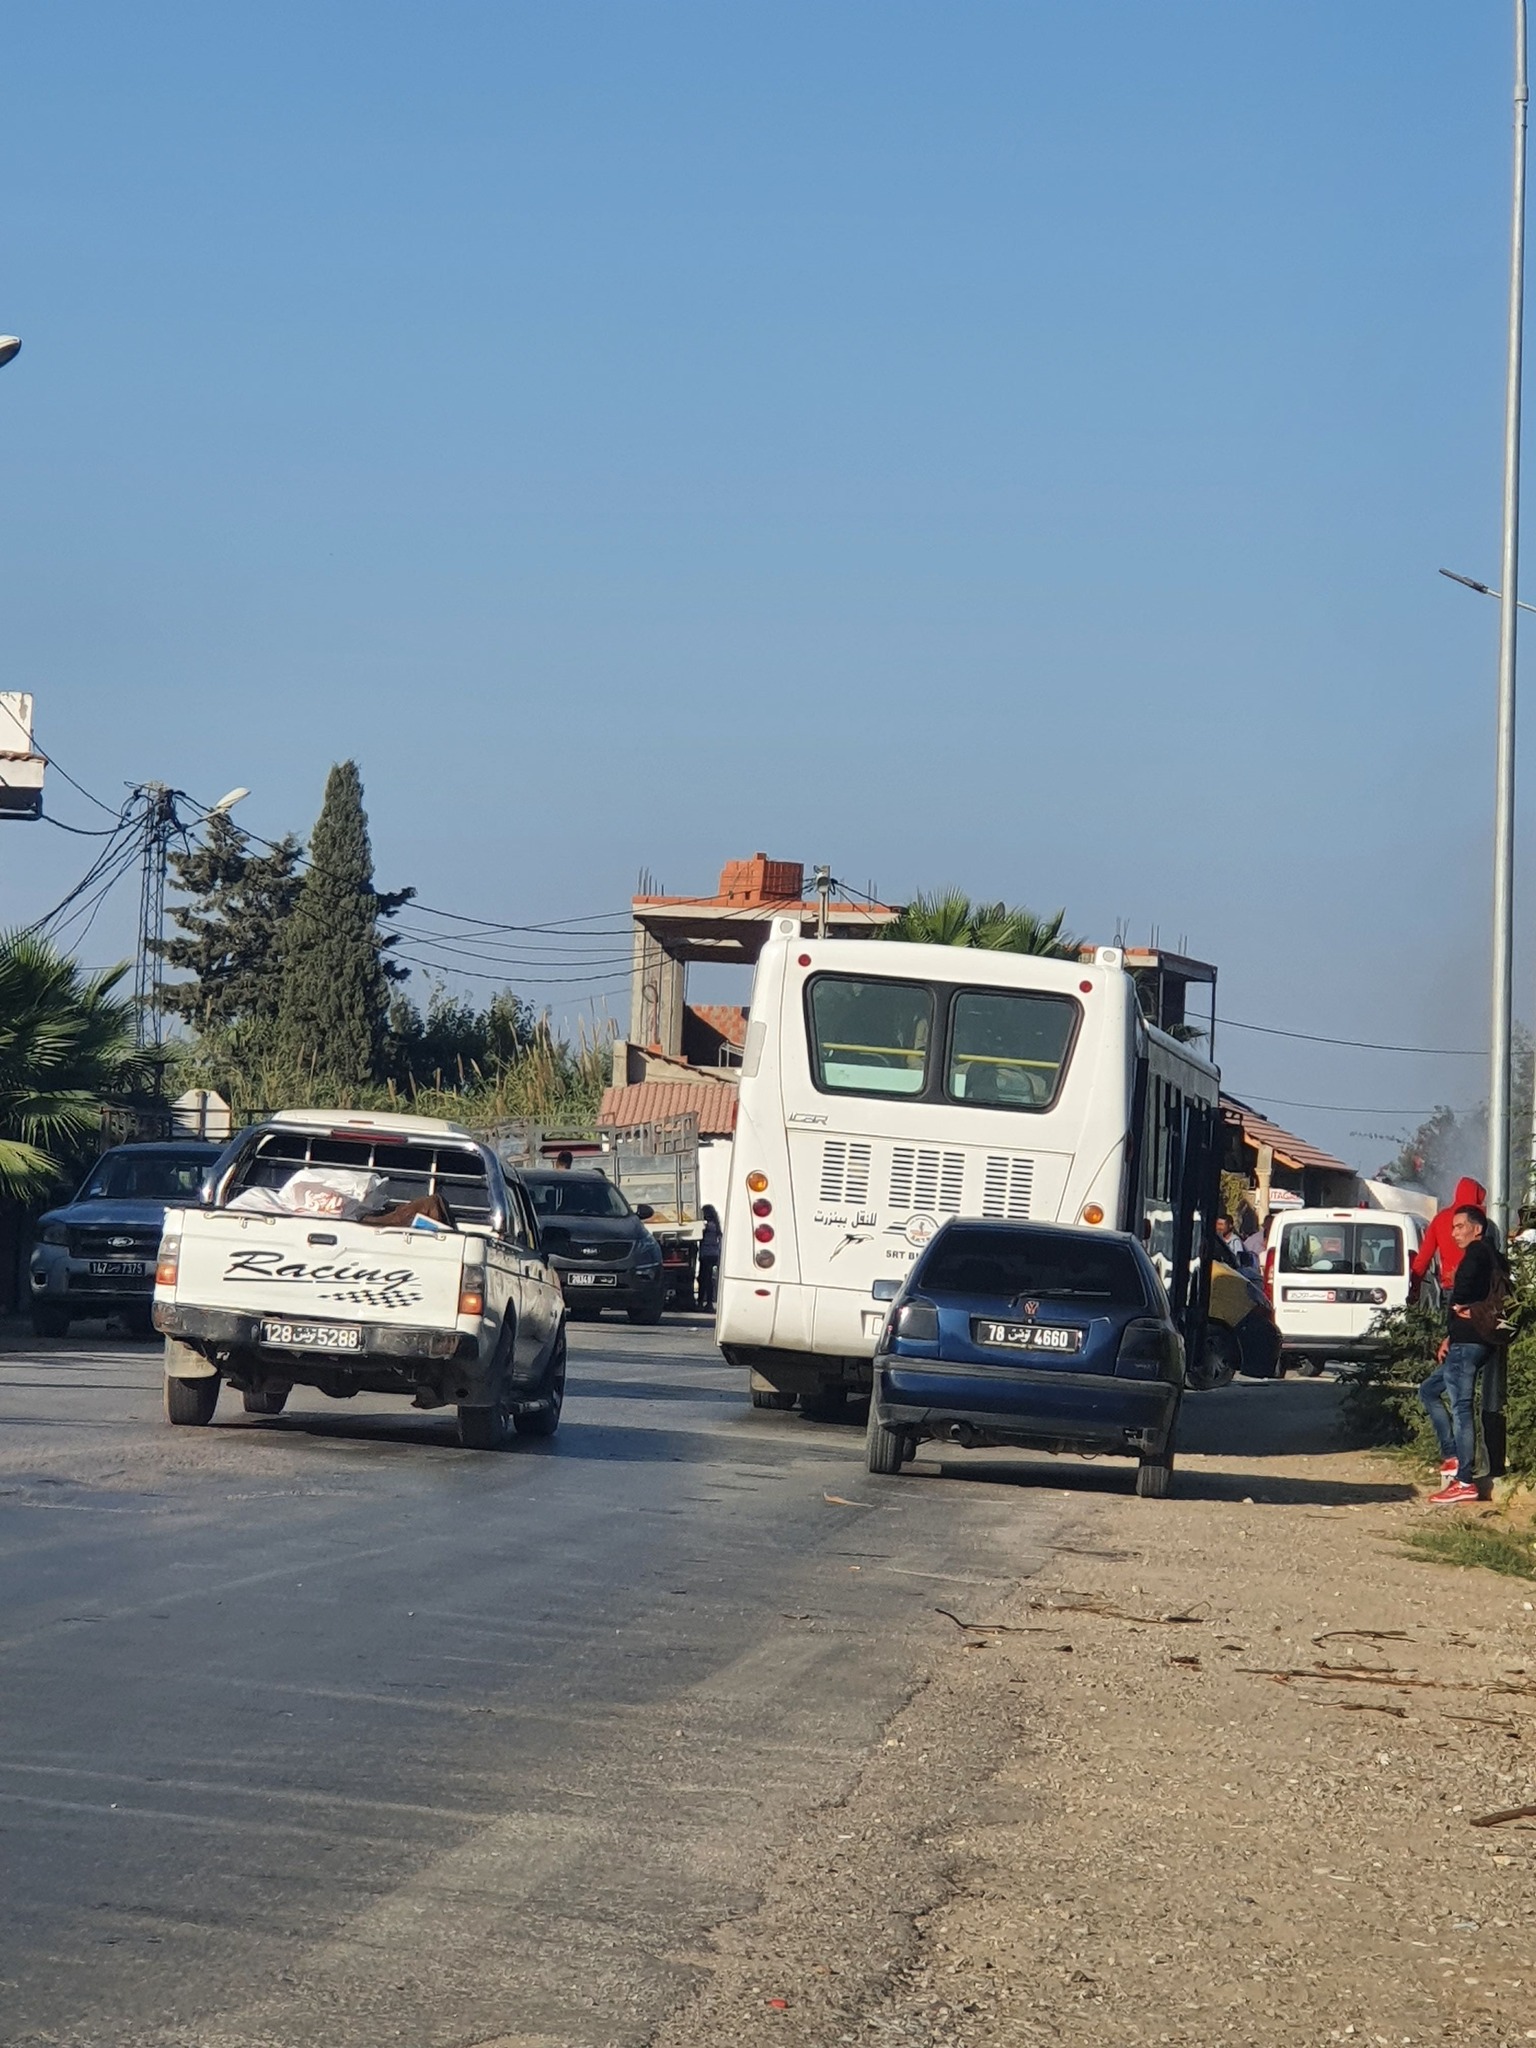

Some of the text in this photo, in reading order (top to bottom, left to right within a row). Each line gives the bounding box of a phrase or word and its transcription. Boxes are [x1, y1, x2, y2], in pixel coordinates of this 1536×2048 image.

[851, 1211, 877, 1228] للنقل
[886, 1249, 905, 1259] SRT
[224, 1250, 420, 1291] Racing
[264, 1323, 292, 1343] 128
[317, 1328, 359, 1348] 5288
[988, 1324, 1005, 1341] 78
[1033, 1329, 1068, 1348] 4660
